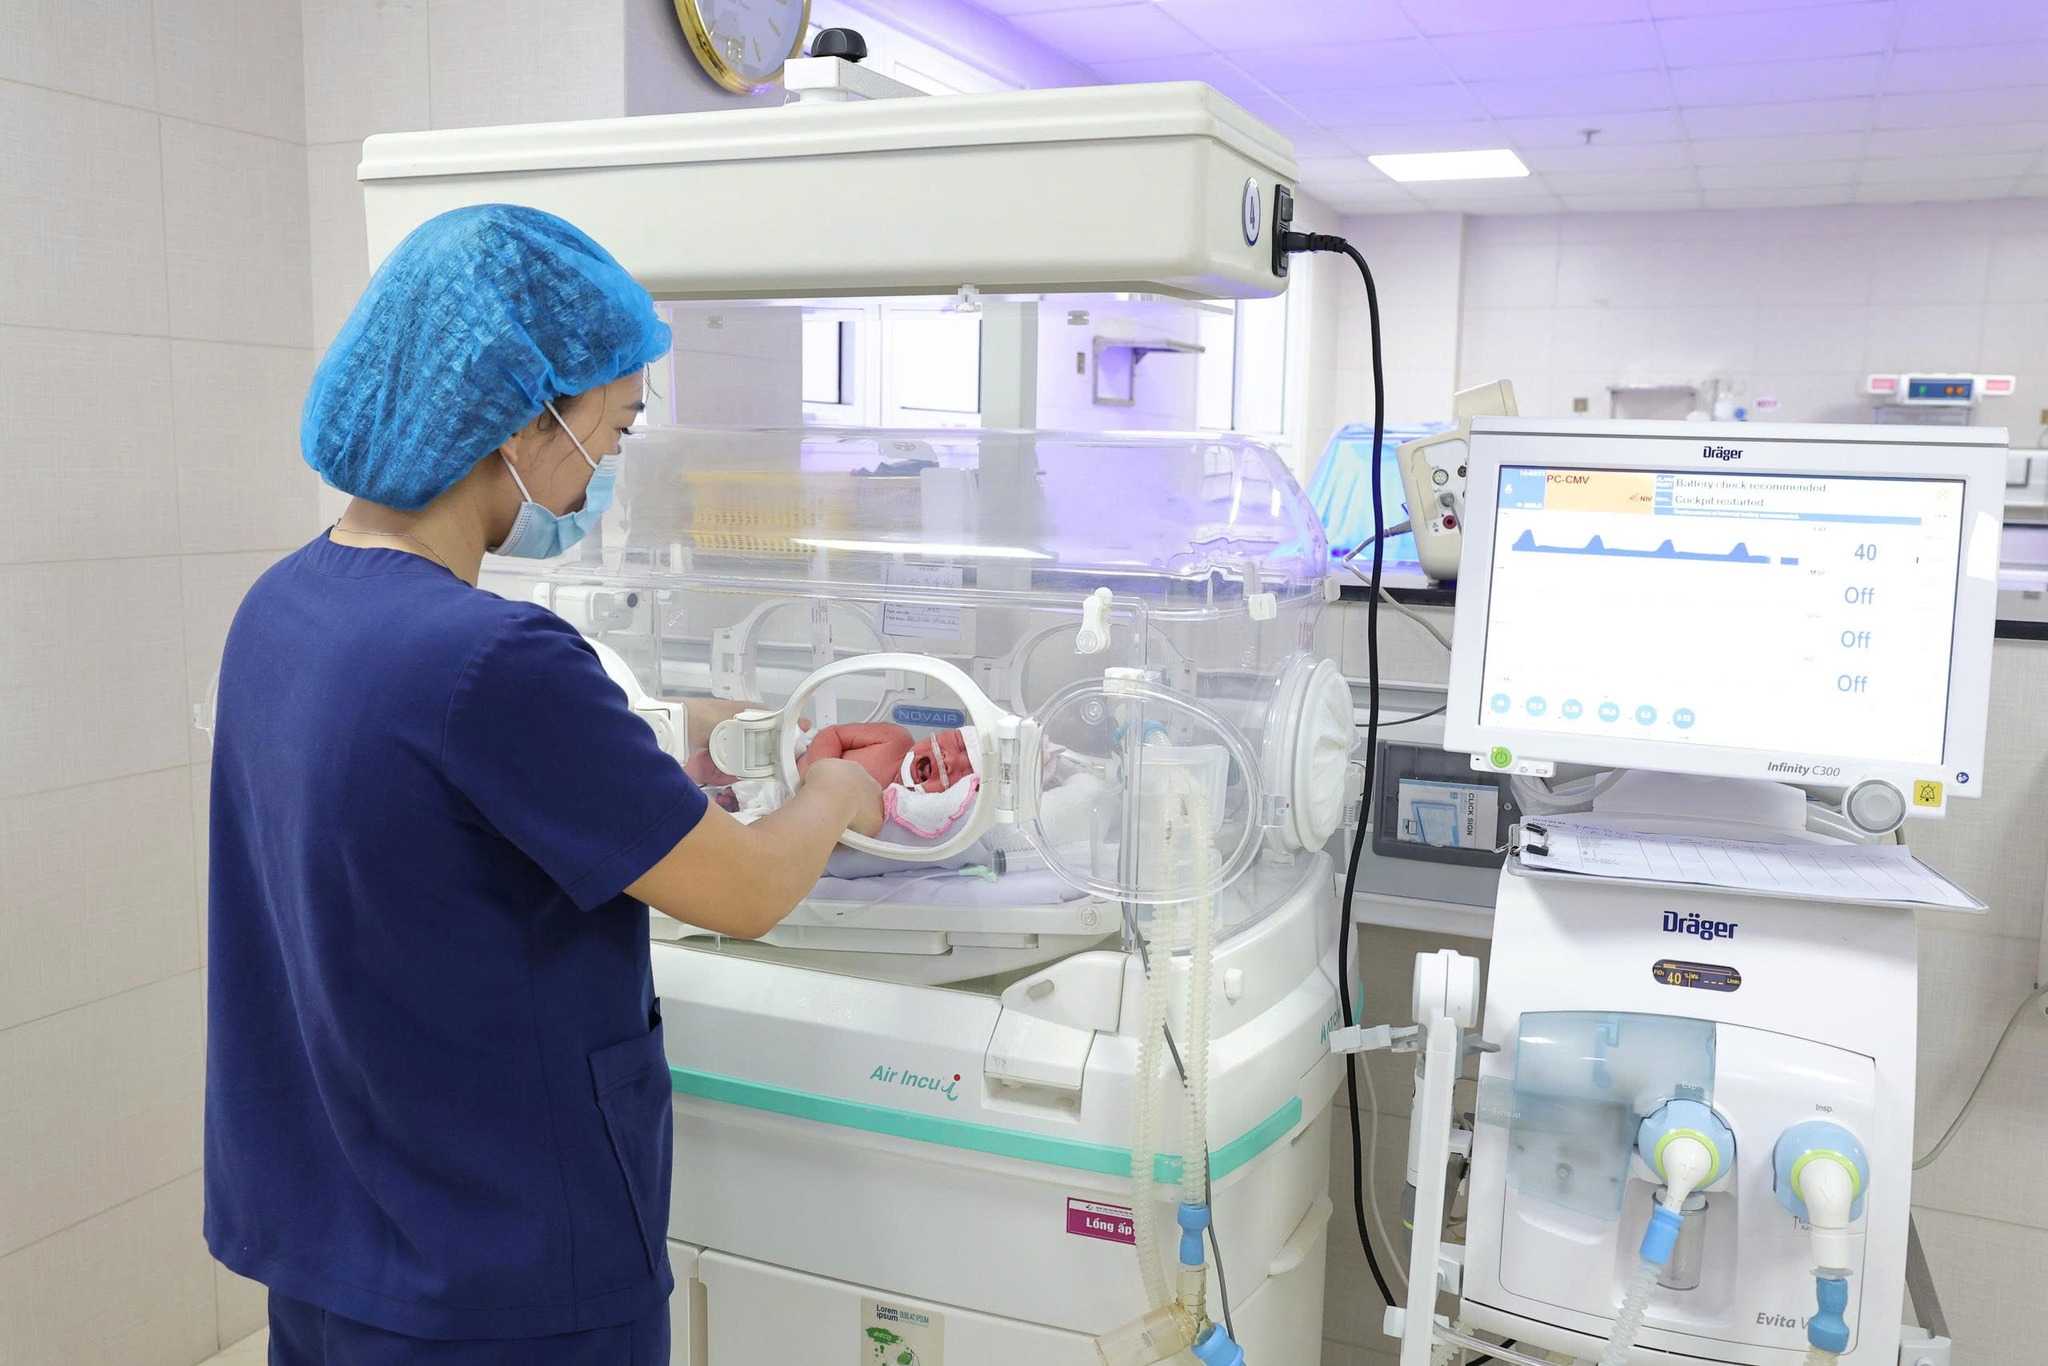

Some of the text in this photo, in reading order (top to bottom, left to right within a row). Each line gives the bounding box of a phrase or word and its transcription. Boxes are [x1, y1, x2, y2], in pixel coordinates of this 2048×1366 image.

[1249, 195, 1256, 230] 4
[1703, 445, 1744, 461] Dräger
[1546, 474, 1591, 485] PC-CMV
[1854, 543, 1877, 561] 40
[1844, 586, 1875, 605] Off
[1841, 630, 1872, 649] Off
[1837, 674, 1868, 693] Off
[897, 710, 958, 724] NOVAIR
[1767, 761, 1841, 777] Infinity C300
[1467, 792, 1475, 816] CLICK
[1663, 910, 1739, 940] Dräger
[1667, 971, 1682, 985] 40
[870, 1064, 898, 1083] Air
[1756, 1311, 1796, 1330] Evita
